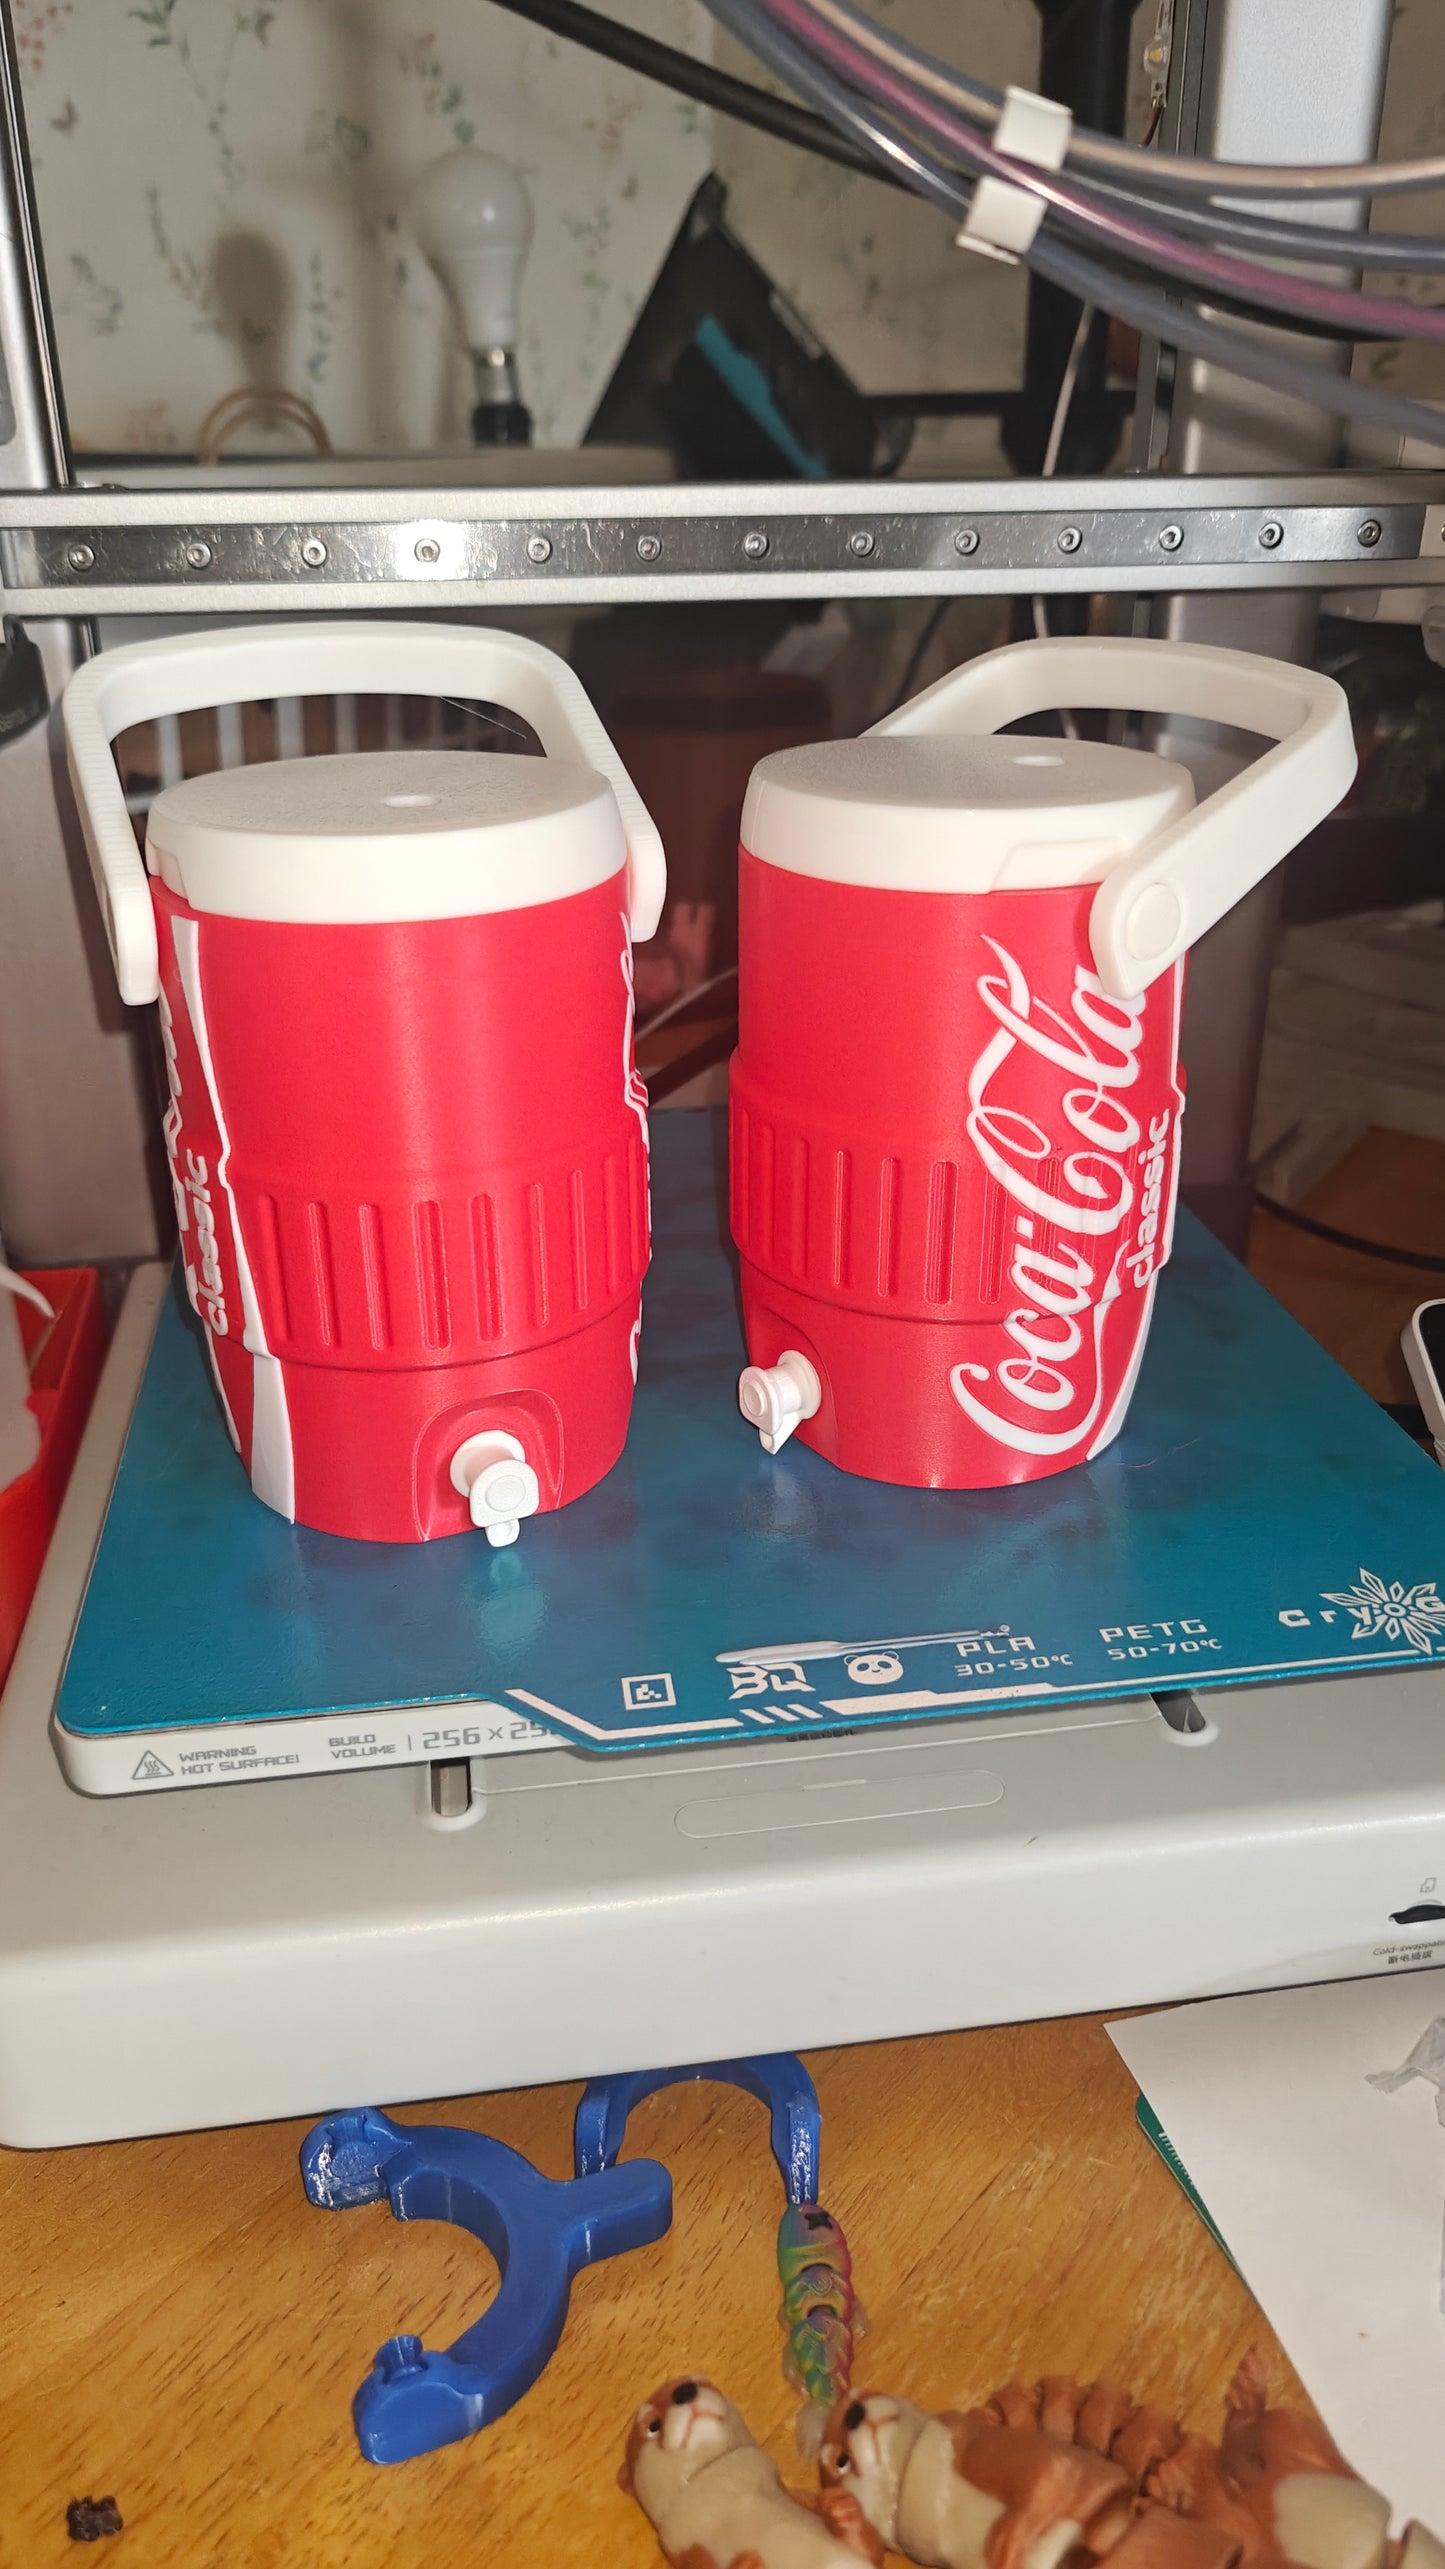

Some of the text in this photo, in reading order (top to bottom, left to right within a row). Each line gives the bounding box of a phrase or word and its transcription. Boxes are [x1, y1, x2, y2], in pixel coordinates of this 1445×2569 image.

[950, 934, 1147, 1455] Coca-Cola
[1124, 1107, 1170, 1288] classic
[1099, 1618, 1208, 1643] PETG
[956, 1635, 1036, 1658] PLA
[328, 1733, 377, 1747] BUILD
[422, 1727, 481, 1750] 256
[510, 1720, 562, 1741] 25
[179, 1745, 257, 1762] WARNING
[331, 1744, 397, 1760] VOLUME
[181, 1754, 300, 1776] HOT SURFACE!
